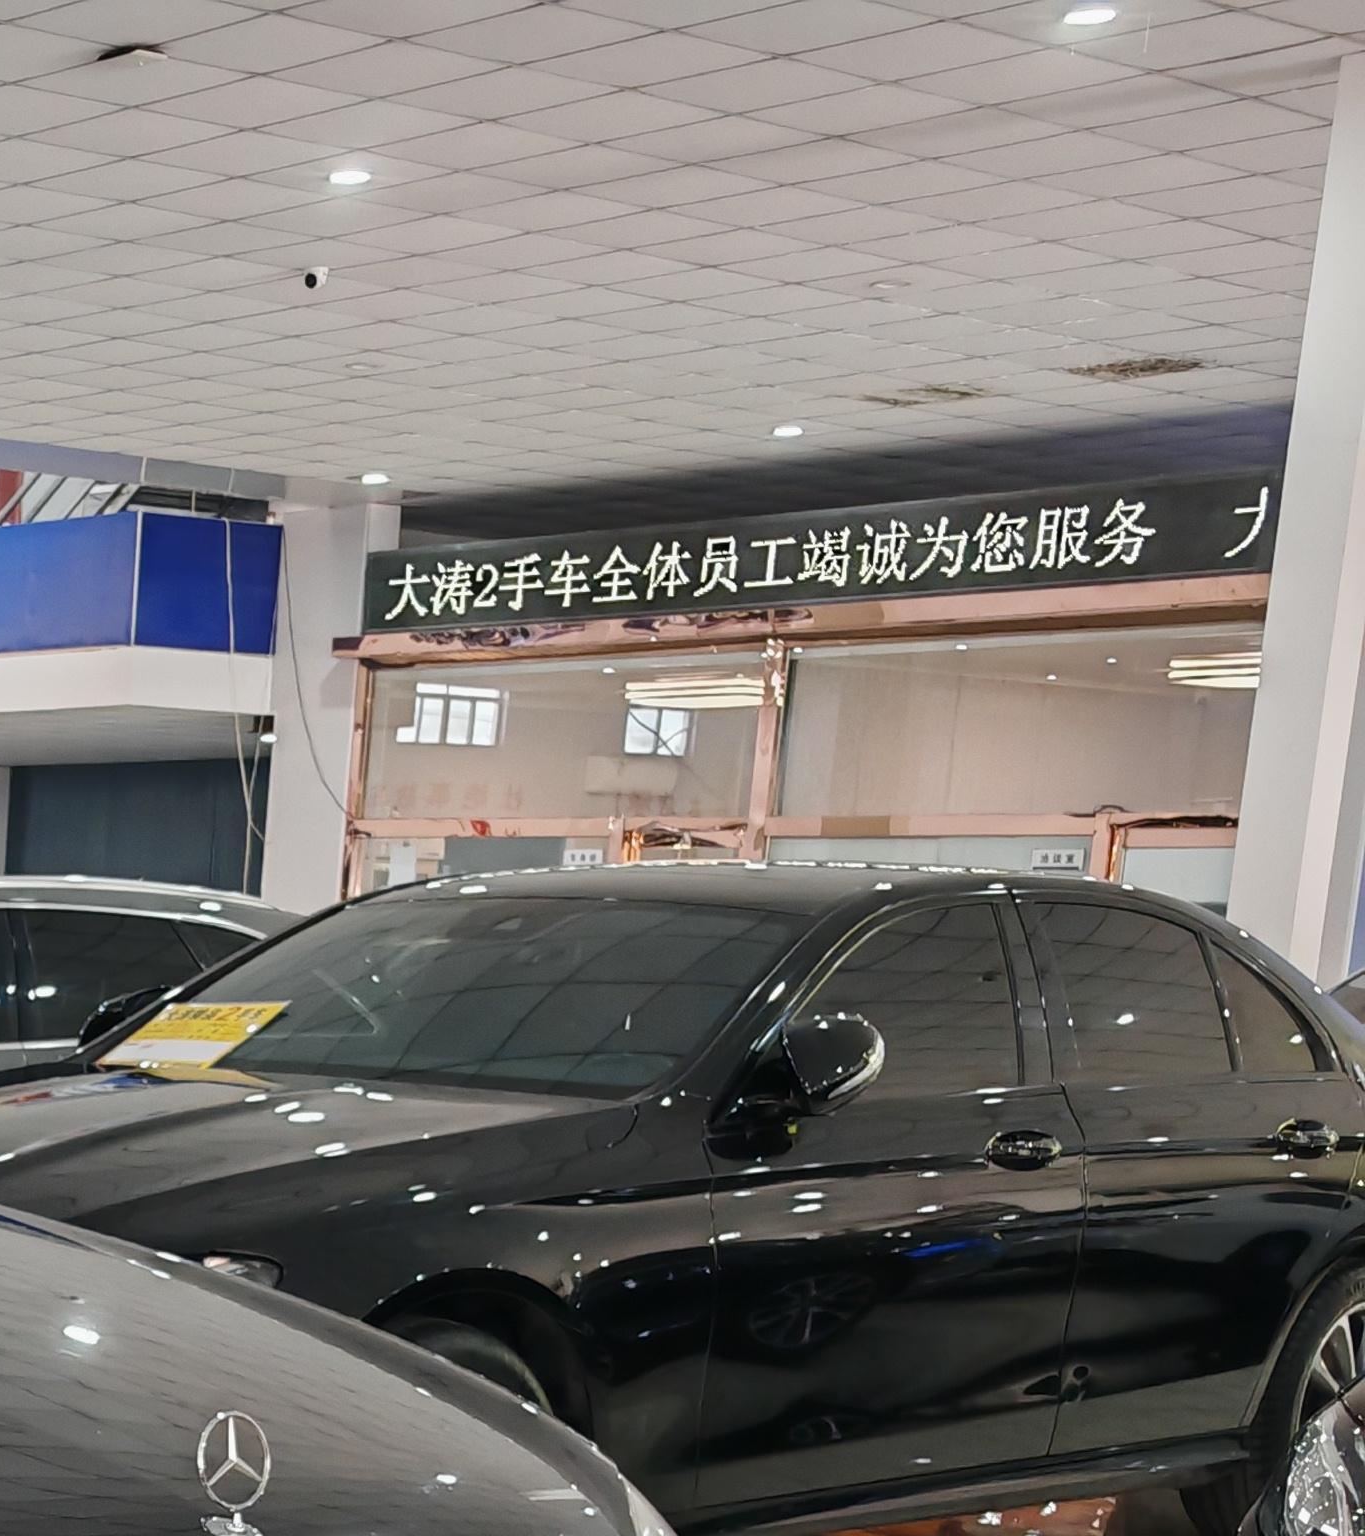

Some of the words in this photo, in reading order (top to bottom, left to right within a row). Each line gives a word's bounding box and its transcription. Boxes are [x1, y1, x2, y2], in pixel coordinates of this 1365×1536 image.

[383, 497, 1157, 621] 大涛2手车全体员工竭诚为您服务
